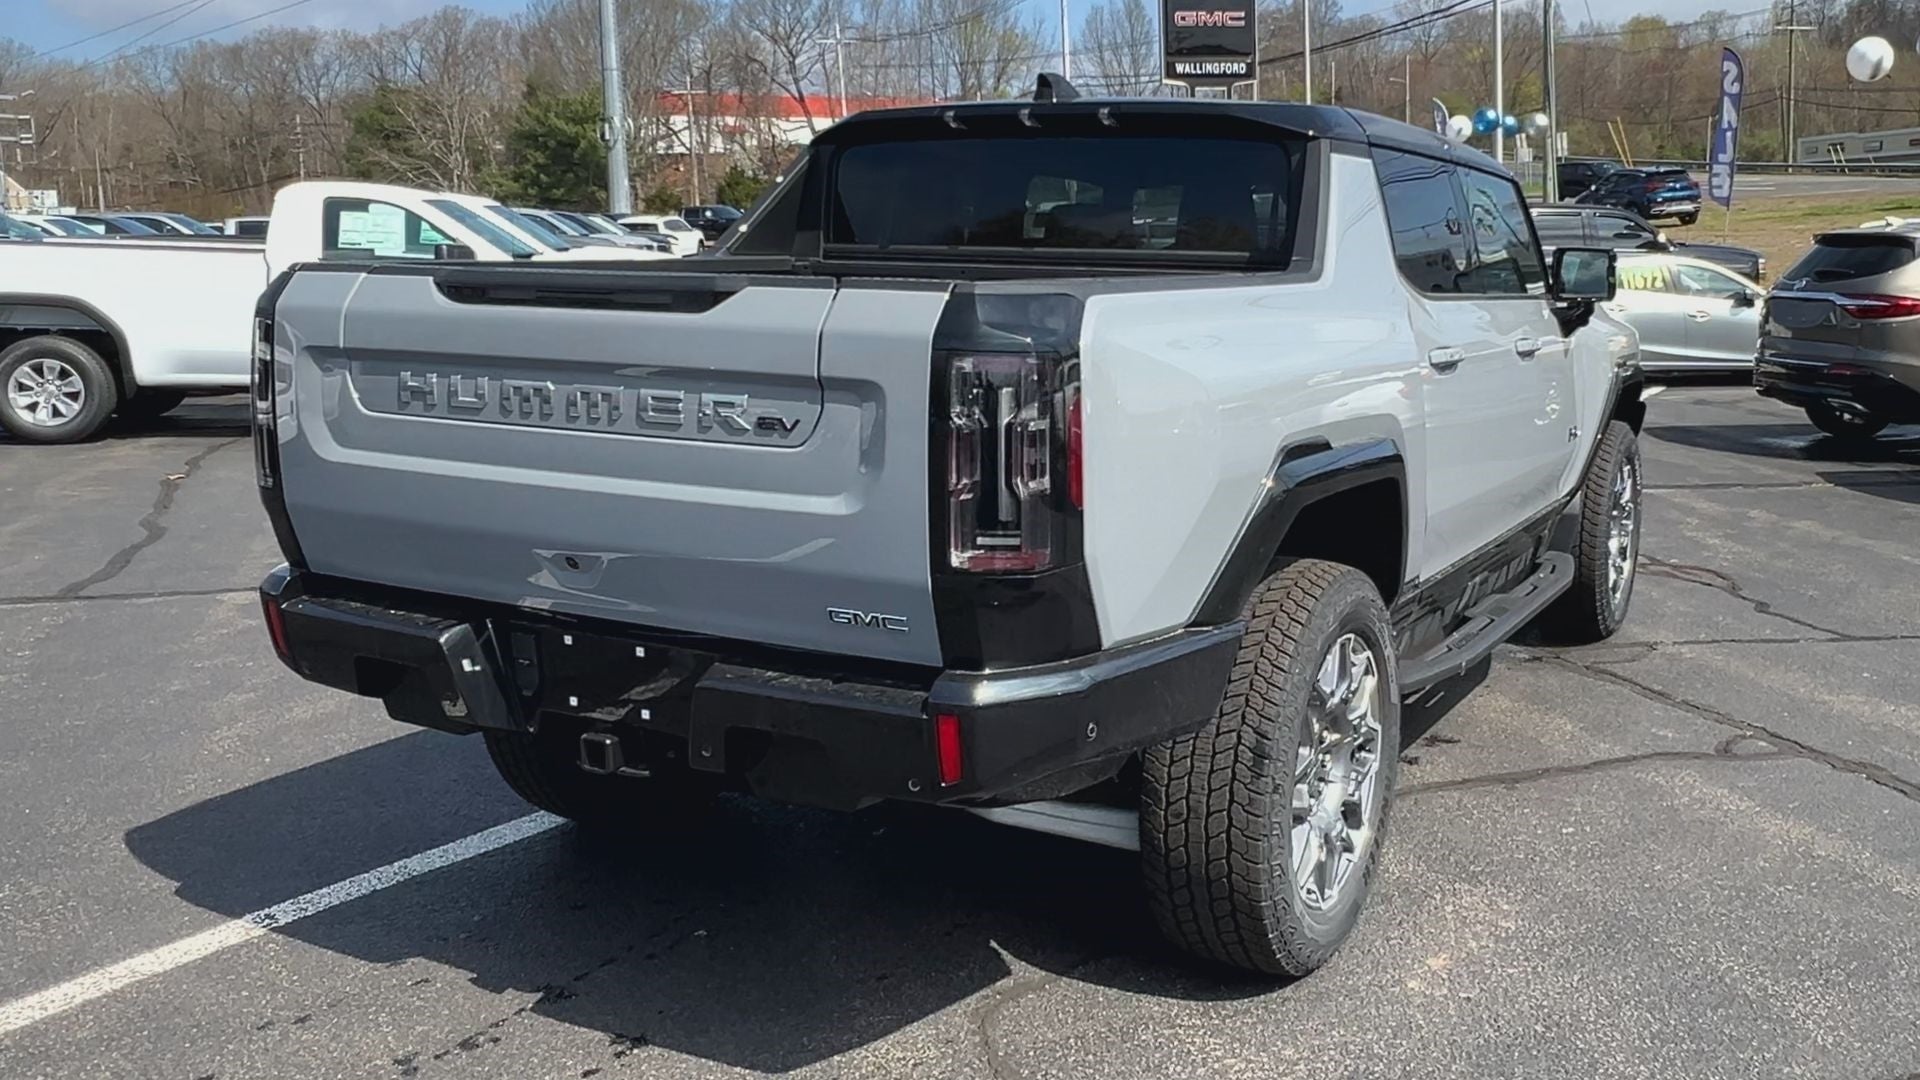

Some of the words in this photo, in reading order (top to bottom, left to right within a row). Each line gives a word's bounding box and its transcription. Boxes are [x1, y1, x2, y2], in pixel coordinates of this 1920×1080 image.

[1174, 11, 1246, 27] GMC
[1175, 62, 1247, 75] WALLINGFORD
[399, 371, 751, 432] HUMMER
[757, 416, 801, 433] EV
[826, 607, 909, 632] GMC
